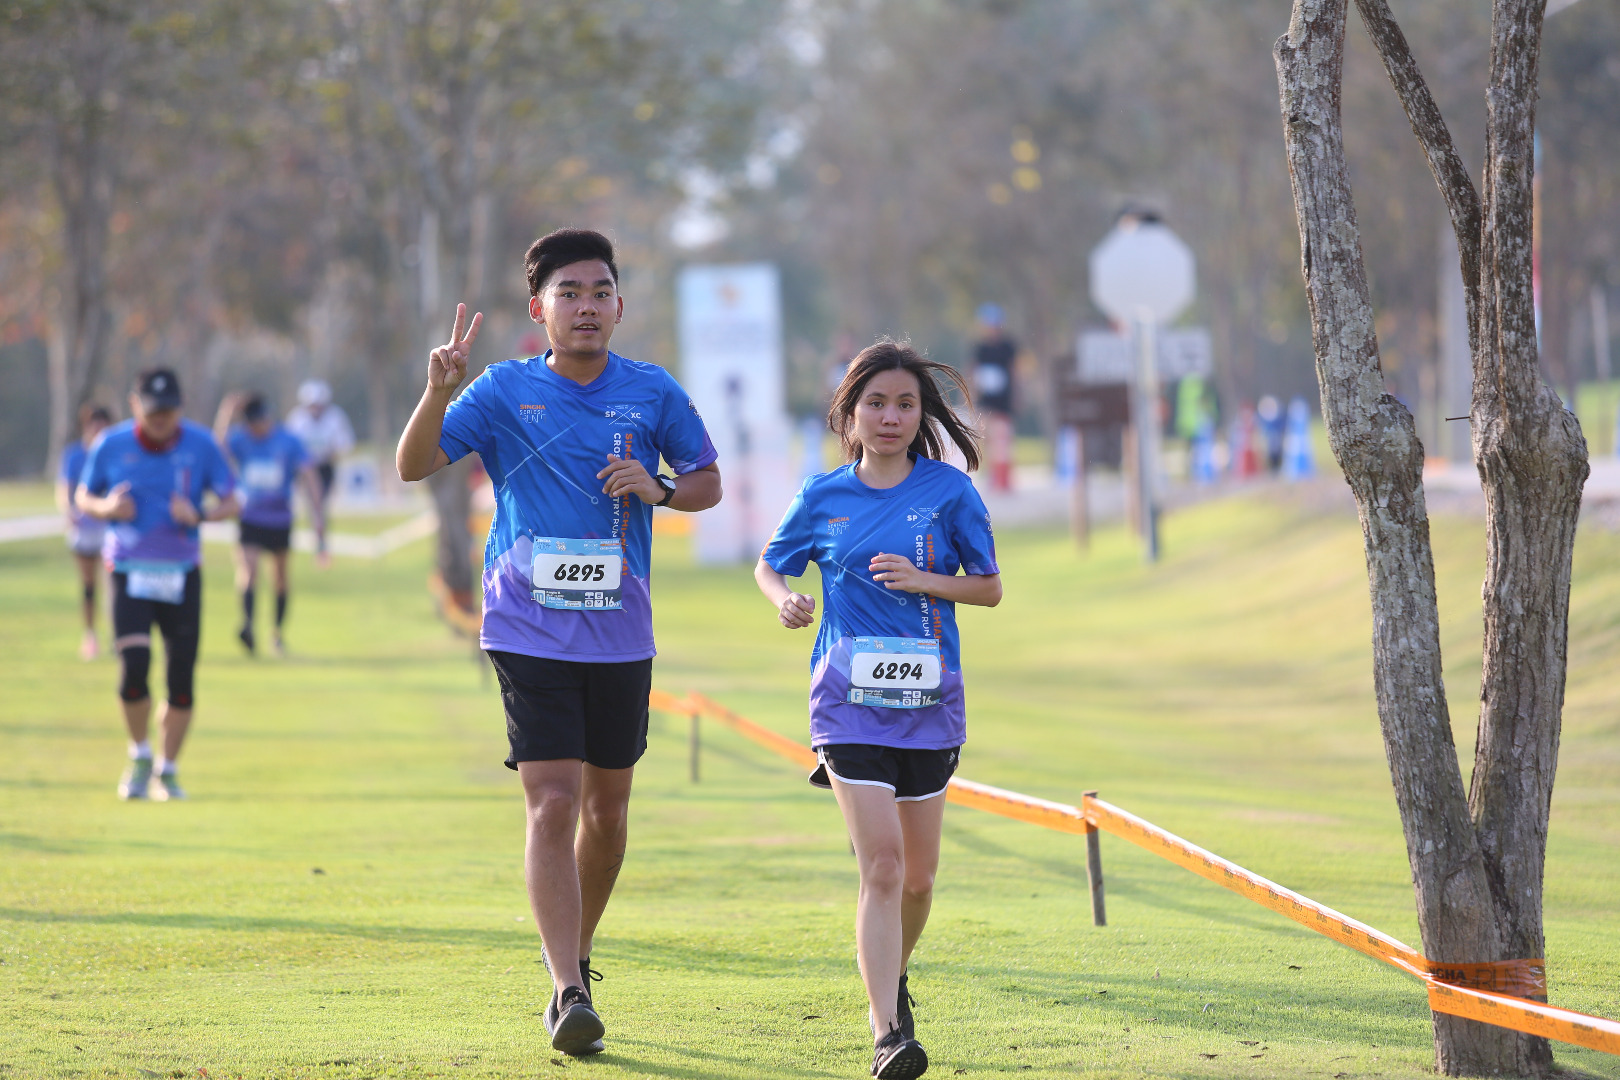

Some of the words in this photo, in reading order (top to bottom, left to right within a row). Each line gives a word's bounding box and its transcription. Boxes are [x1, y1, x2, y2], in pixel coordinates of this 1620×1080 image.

[613, 433, 621, 458] CROS
[625, 433, 633, 460] SING
[554, 563, 605, 582] 6295
[915, 534, 924, 568] CROSS
[921, 616, 931, 637] RUN
[872, 662, 923, 680] 6294
